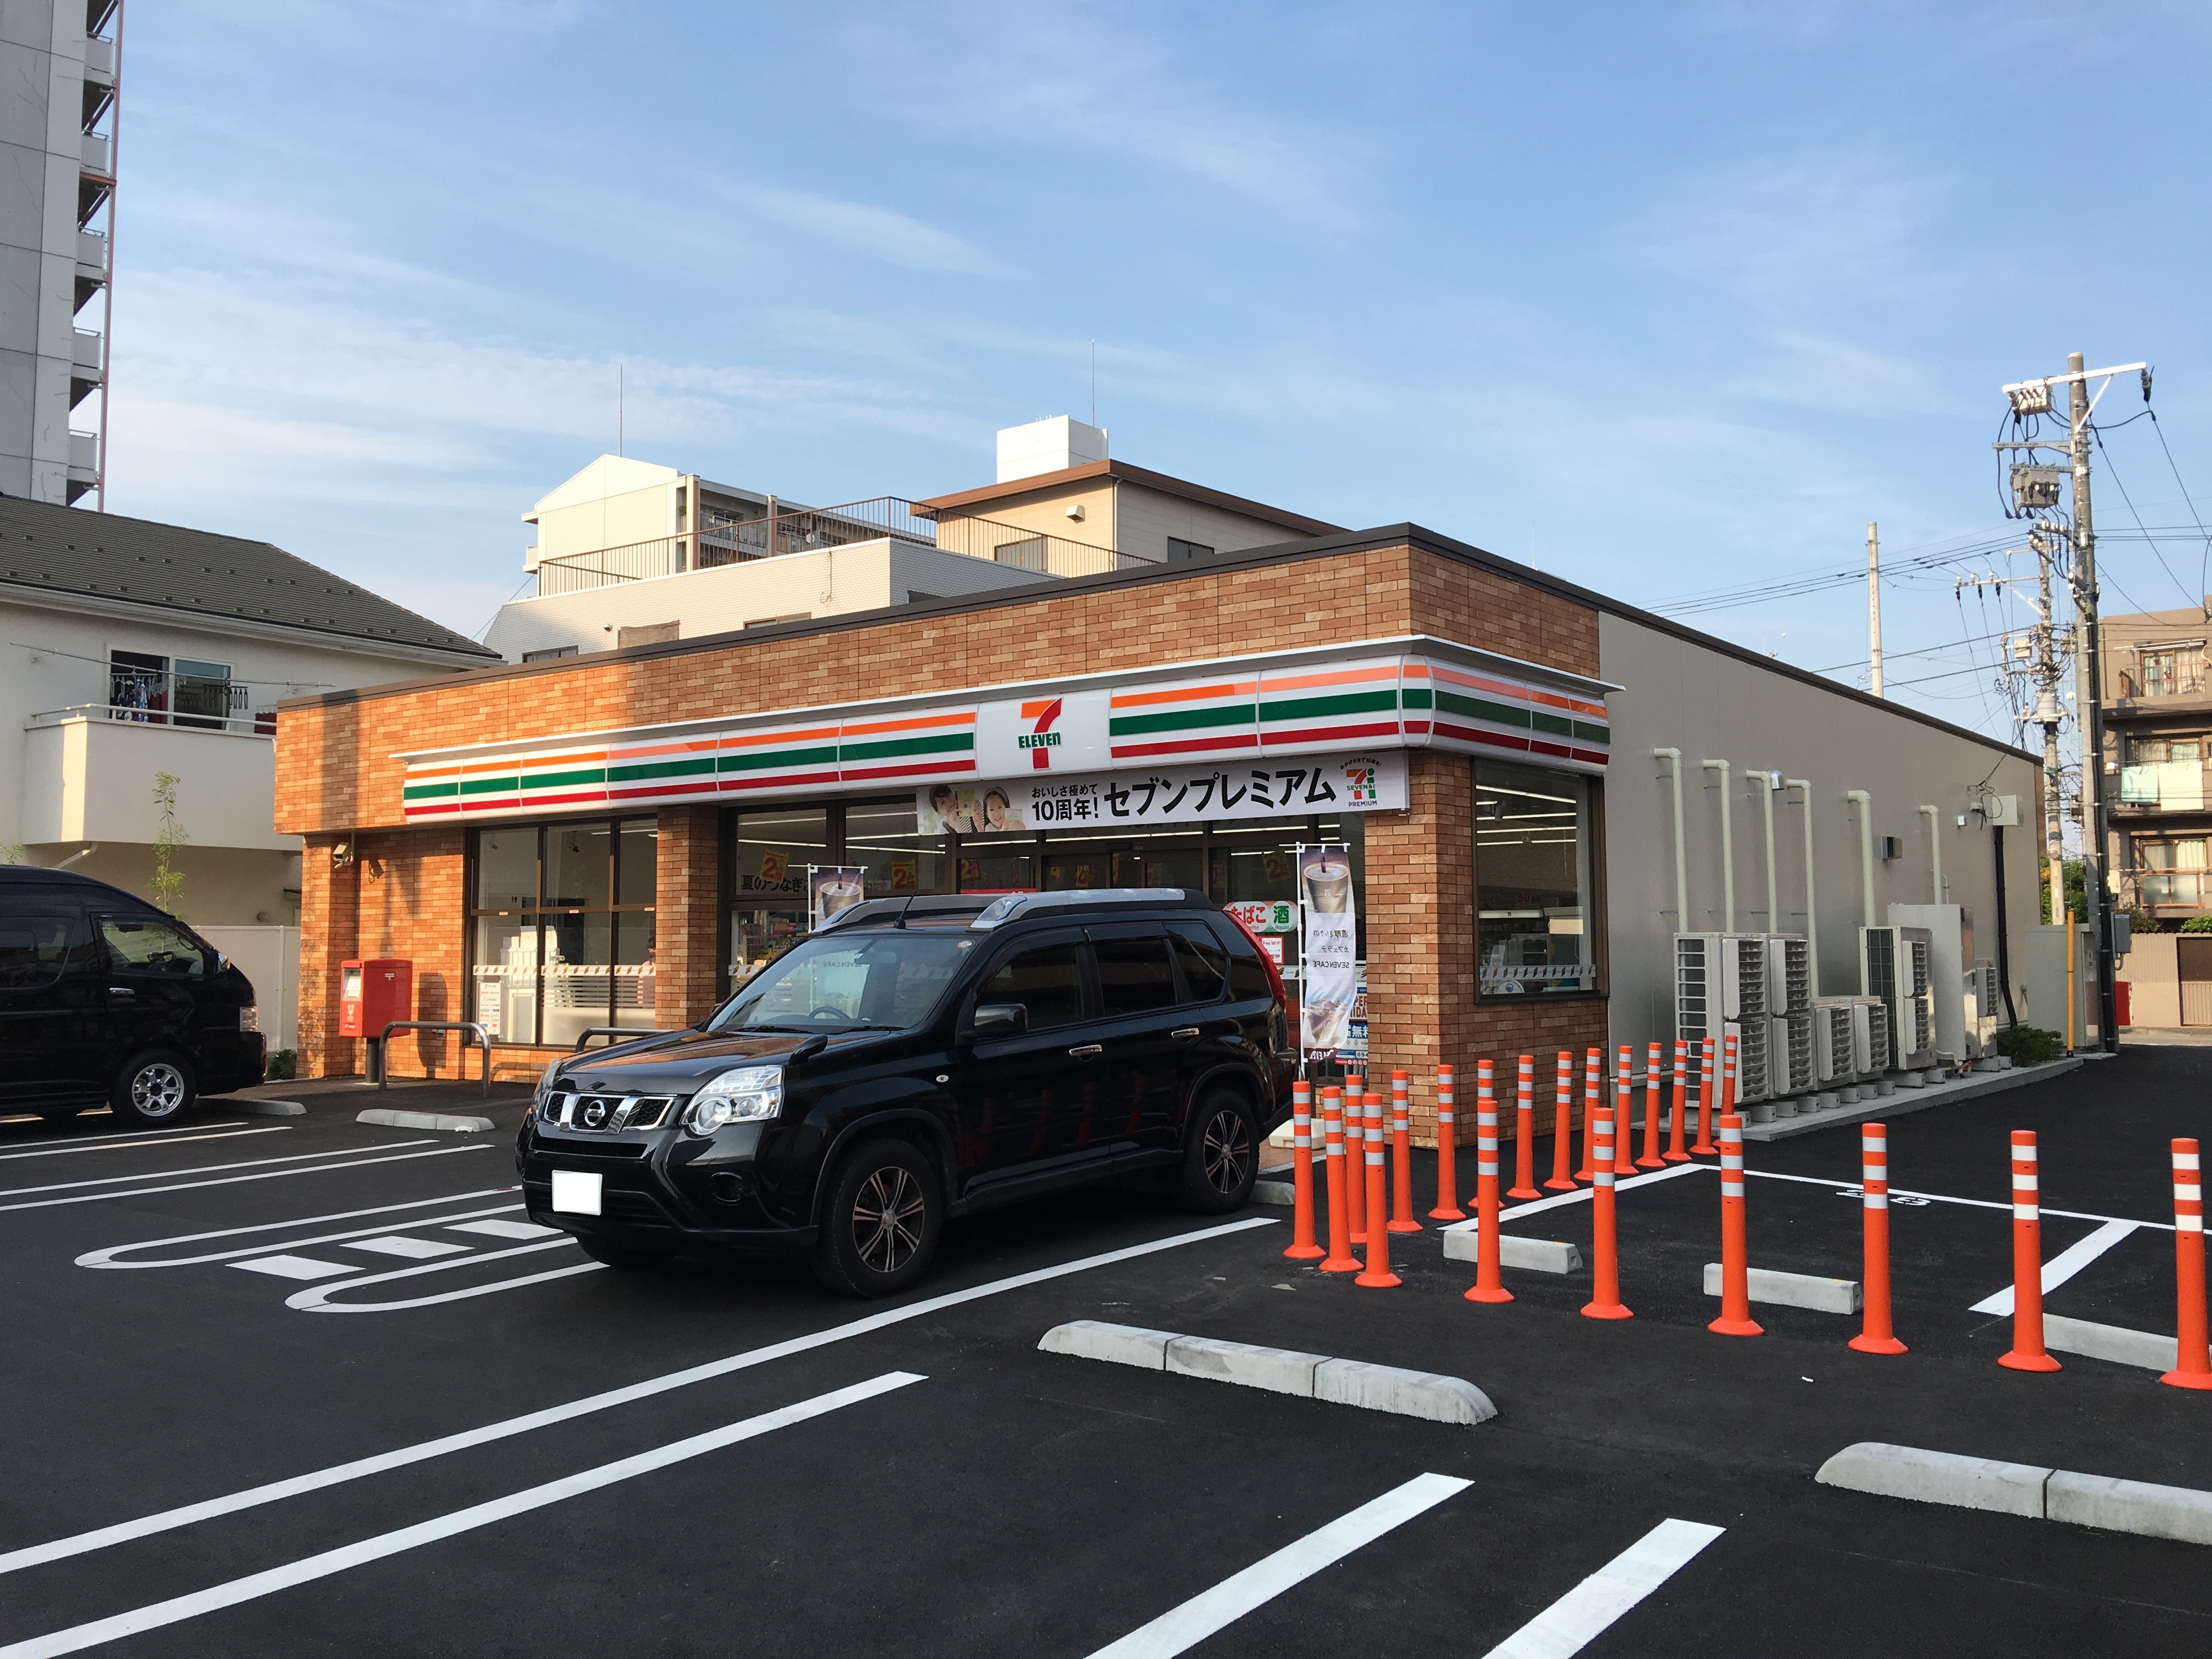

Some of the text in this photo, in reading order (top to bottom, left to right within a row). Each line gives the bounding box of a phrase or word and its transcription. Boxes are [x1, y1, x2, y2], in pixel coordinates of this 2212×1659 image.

[1032, 783, 1098, 798] おいしさ極めて
[1104, 767, 1337, 817] セブンプレミアム
[1031, 797, 1099, 821] 10周年!
[1273, 905, 1289, 924] 酒
